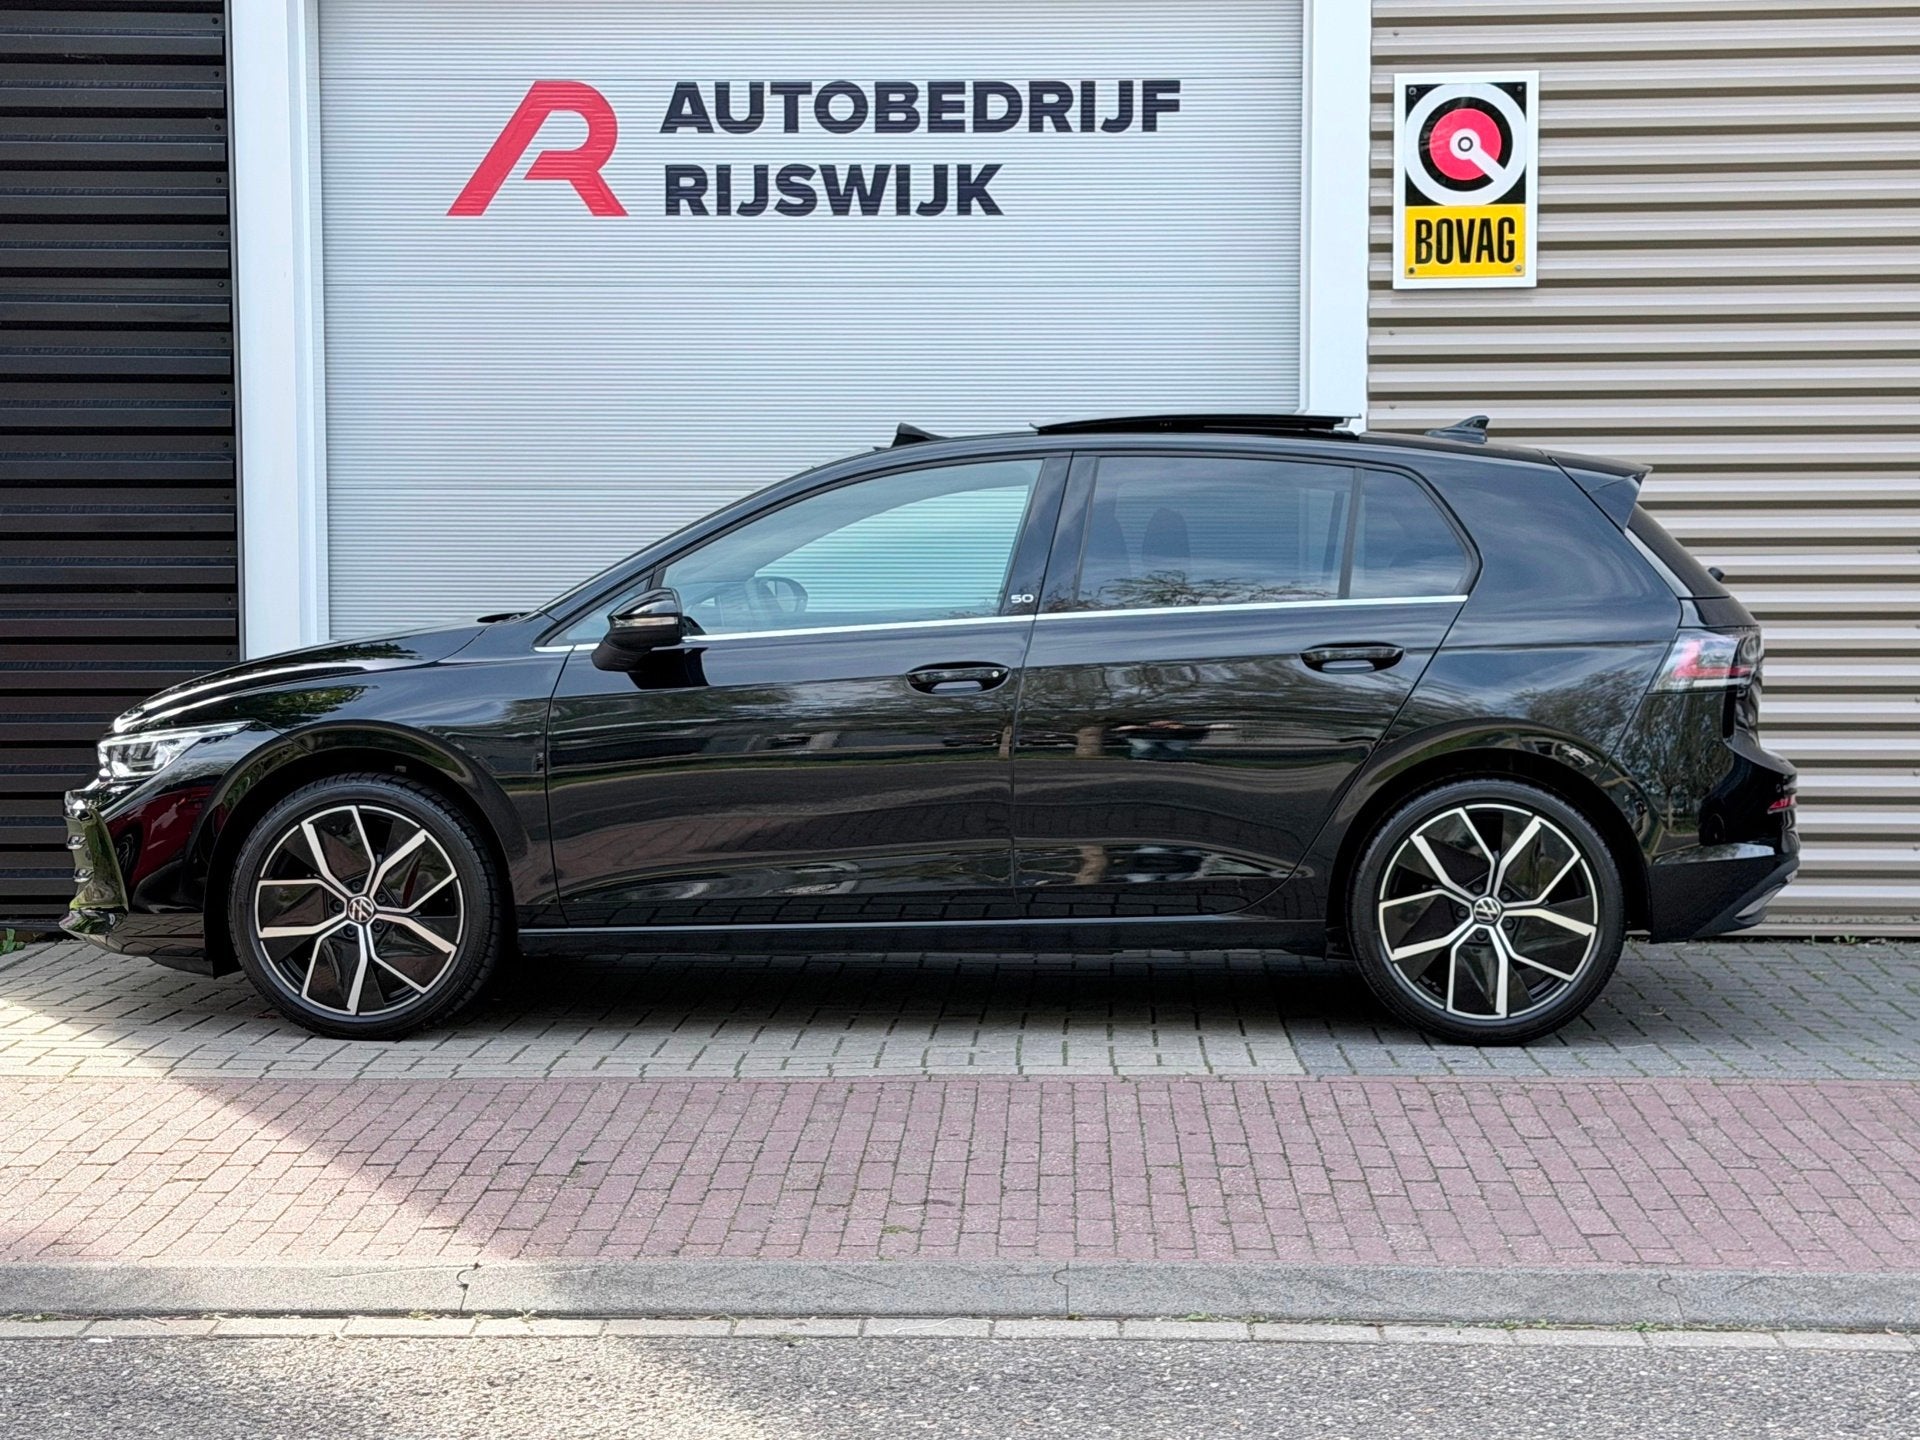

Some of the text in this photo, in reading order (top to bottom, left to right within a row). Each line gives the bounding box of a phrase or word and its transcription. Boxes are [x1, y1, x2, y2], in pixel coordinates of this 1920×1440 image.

[660, 79, 1181, 134] AUTOBEDRIJF
[665, 164, 1003, 216] RIJSWIJK
[1414, 217, 1516, 264] BOVAG
[1010, 593, 1034, 604] 50
